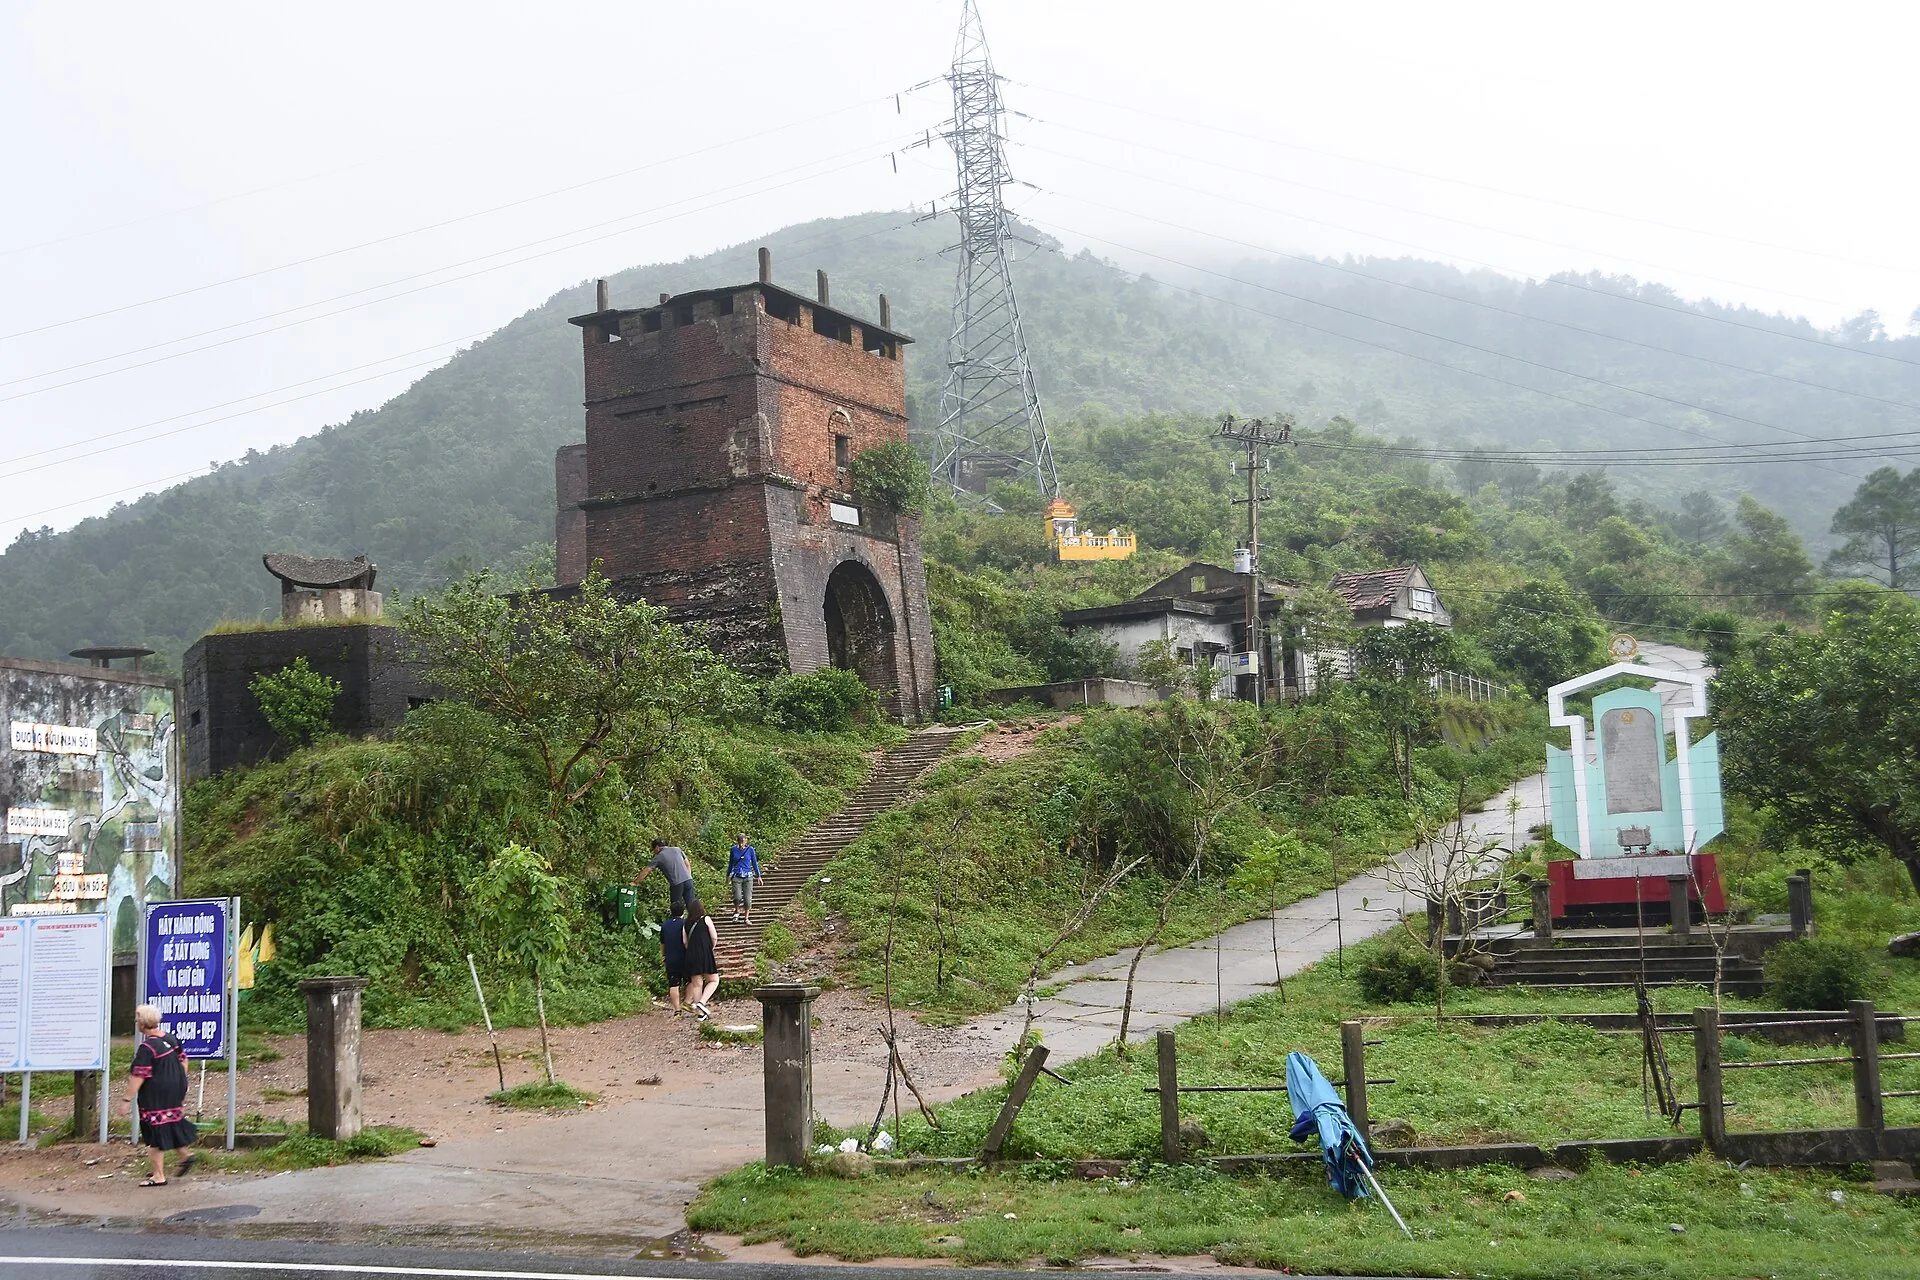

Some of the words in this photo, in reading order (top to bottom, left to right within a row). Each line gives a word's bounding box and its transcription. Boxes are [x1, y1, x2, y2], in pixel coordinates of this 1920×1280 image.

[158, 914, 174, 936] HÃY
[173, 913, 194, 935] HÀNH
[194, 912, 215, 938] ĐỘNG
[174, 939, 190, 961] XÂY
[189, 940, 210, 964] DỰNG
[167, 966, 177, 988] VÀ
[172, 989, 189, 1014] PHỐ
[188, 991, 200, 1014] ĐÀ
[200, 988, 221, 1013] NẴNG
[176, 1021, 197, 1045] SẠCH
[201, 1021, 217, 1044] ĐẸP
